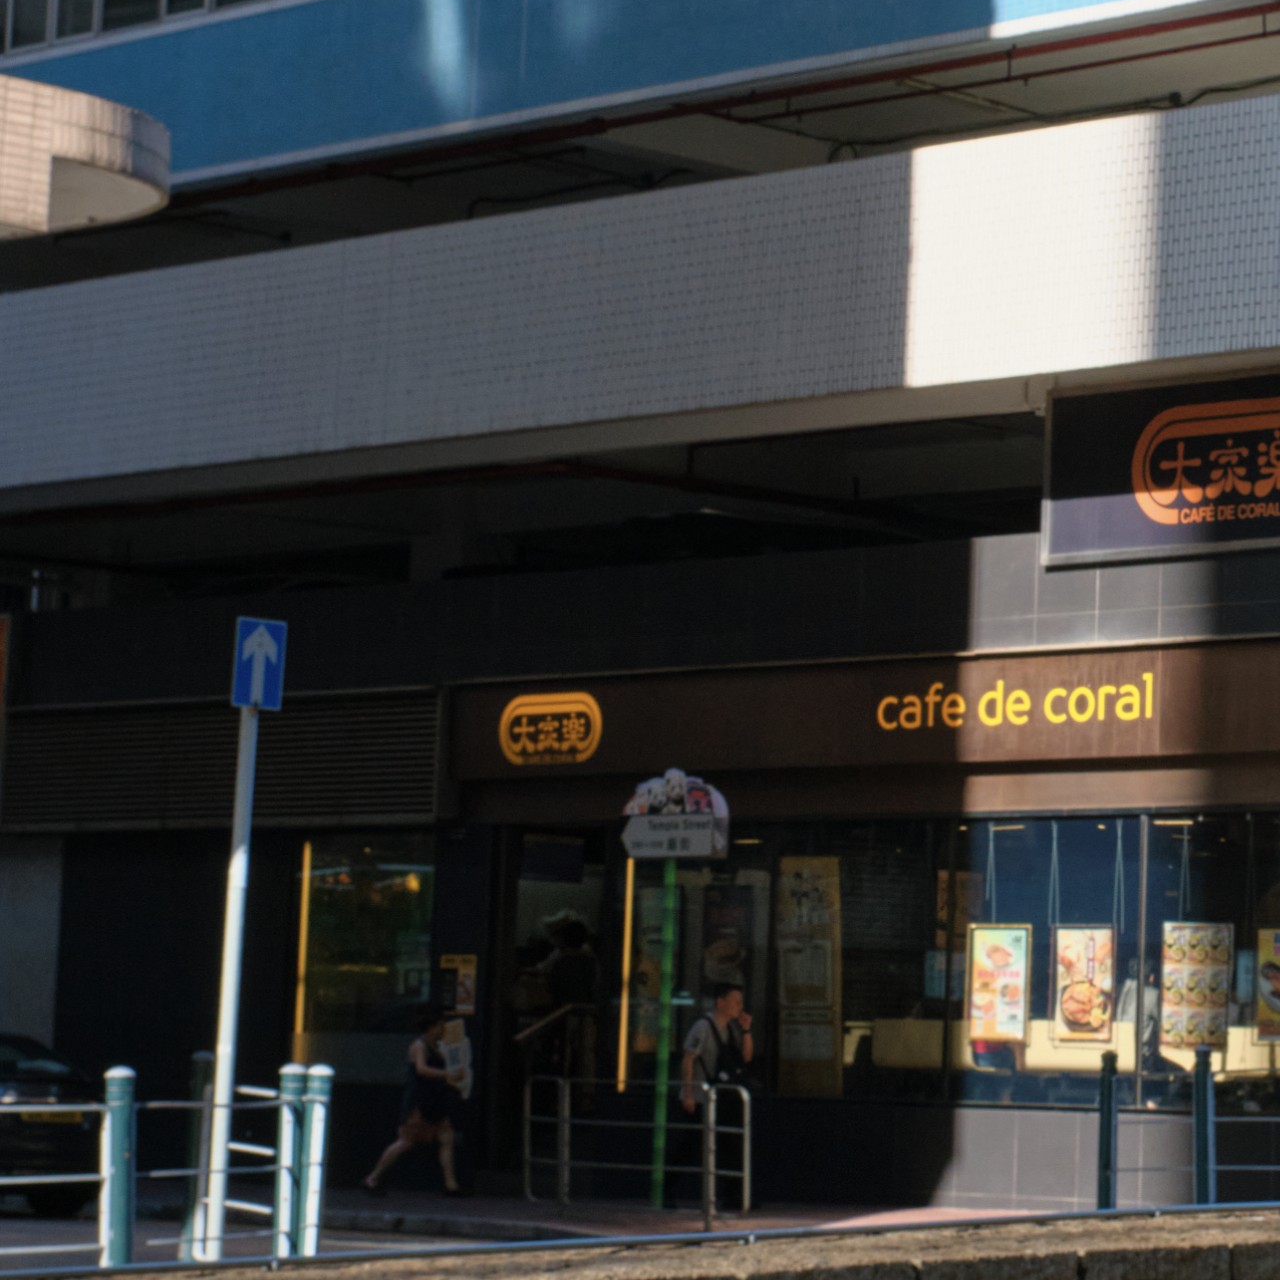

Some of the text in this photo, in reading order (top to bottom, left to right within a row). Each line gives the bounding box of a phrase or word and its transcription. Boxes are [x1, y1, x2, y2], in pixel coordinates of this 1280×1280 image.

[1217, 504, 1235, 521] DE
[877, 672, 1154, 731] cafe de coral
